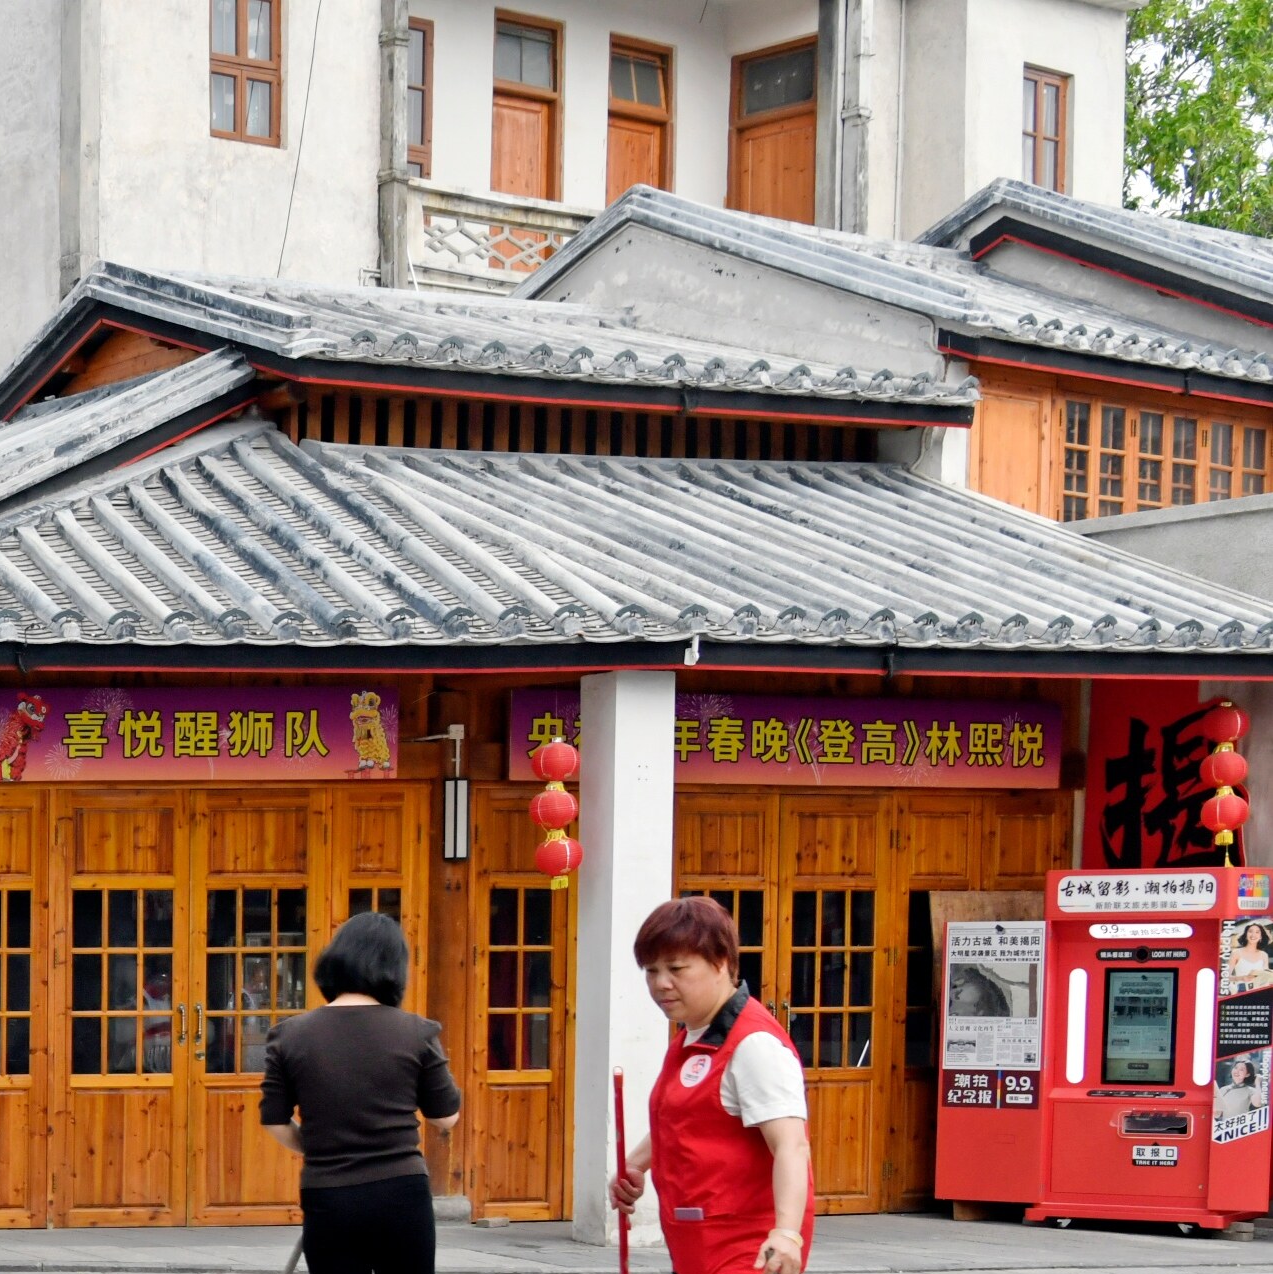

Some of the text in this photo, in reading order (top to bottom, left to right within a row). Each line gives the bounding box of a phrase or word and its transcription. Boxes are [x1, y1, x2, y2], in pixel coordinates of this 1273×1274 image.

[61, 708, 330, 760] 喜悦醒狮队
[674, 716, 1046, 768] 年春晚《登高》林熙悦
[951, 935, 1041, 947] 活力古城 和美揭阳
[954, 1073, 989, 1088] 潮拍
[947, 1089, 992, 1105] 纪念报
[1136, 1147, 1175, 1157] 取报口
